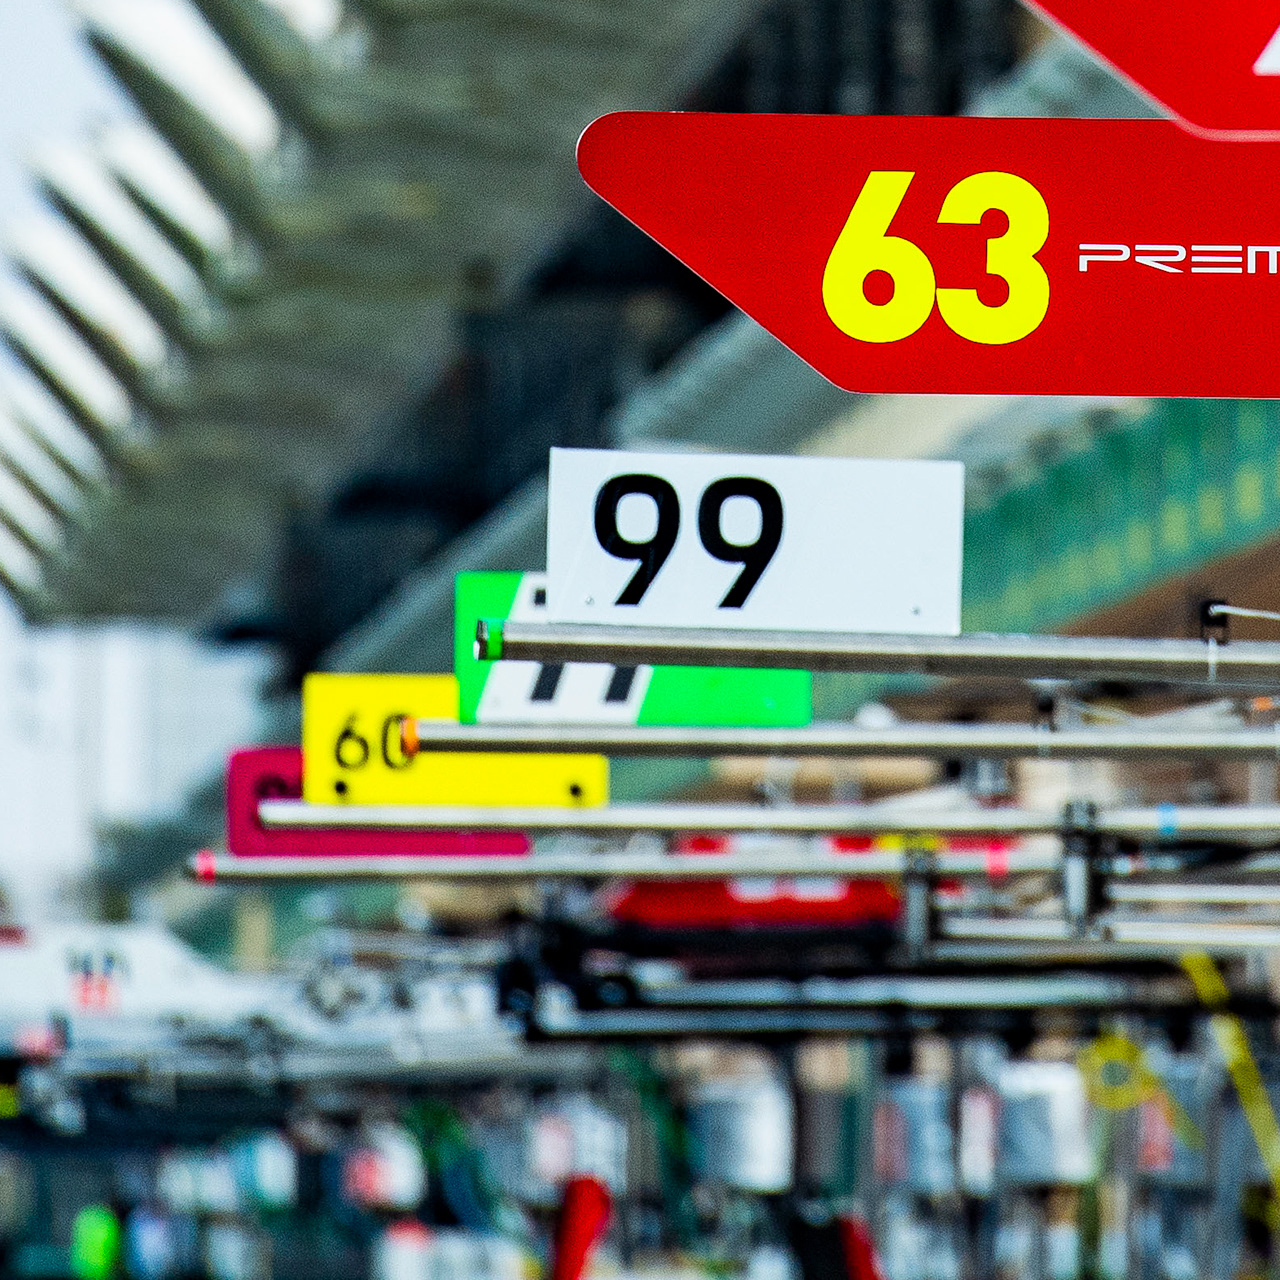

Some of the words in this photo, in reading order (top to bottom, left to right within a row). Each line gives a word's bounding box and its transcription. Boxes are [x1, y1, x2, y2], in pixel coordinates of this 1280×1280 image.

[821, 170, 1050, 345] 63
[594, 473, 784, 609] 99
[335, 712, 418, 770] 60
